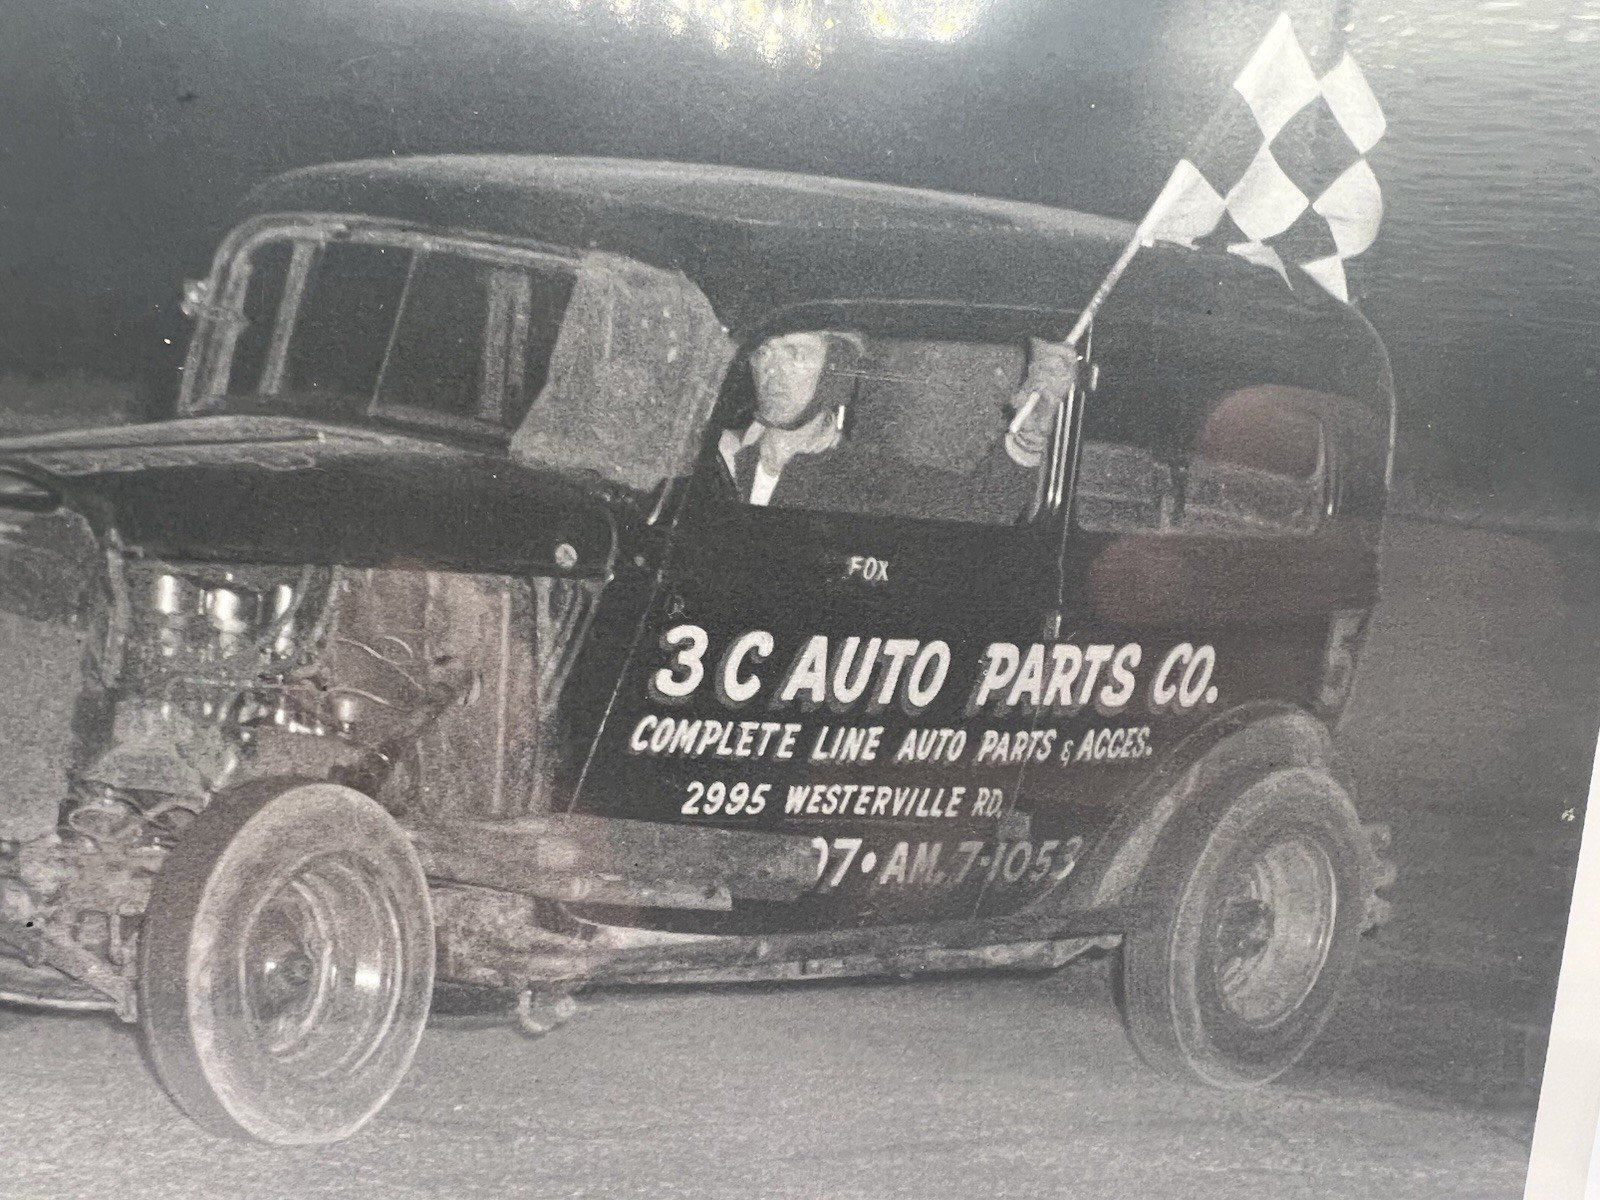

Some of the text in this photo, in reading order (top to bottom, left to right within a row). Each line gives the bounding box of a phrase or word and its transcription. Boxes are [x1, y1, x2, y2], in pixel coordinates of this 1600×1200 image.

[848, 555, 889, 581] FOX
[655, 624, 1218, 707] 3 C AUTO PARTS CO.
[630, 715, 801, 759] COMPLETE
[812, 726, 884, 760] LINE
[897, 728, 967, 762] AUTO
[977, 728, 1057, 762] PARTS
[1076, 727, 1153, 761] ACCES.
[681, 781, 772, 815] 2995
[784, 784, 966, 818] WESTERVILLE
